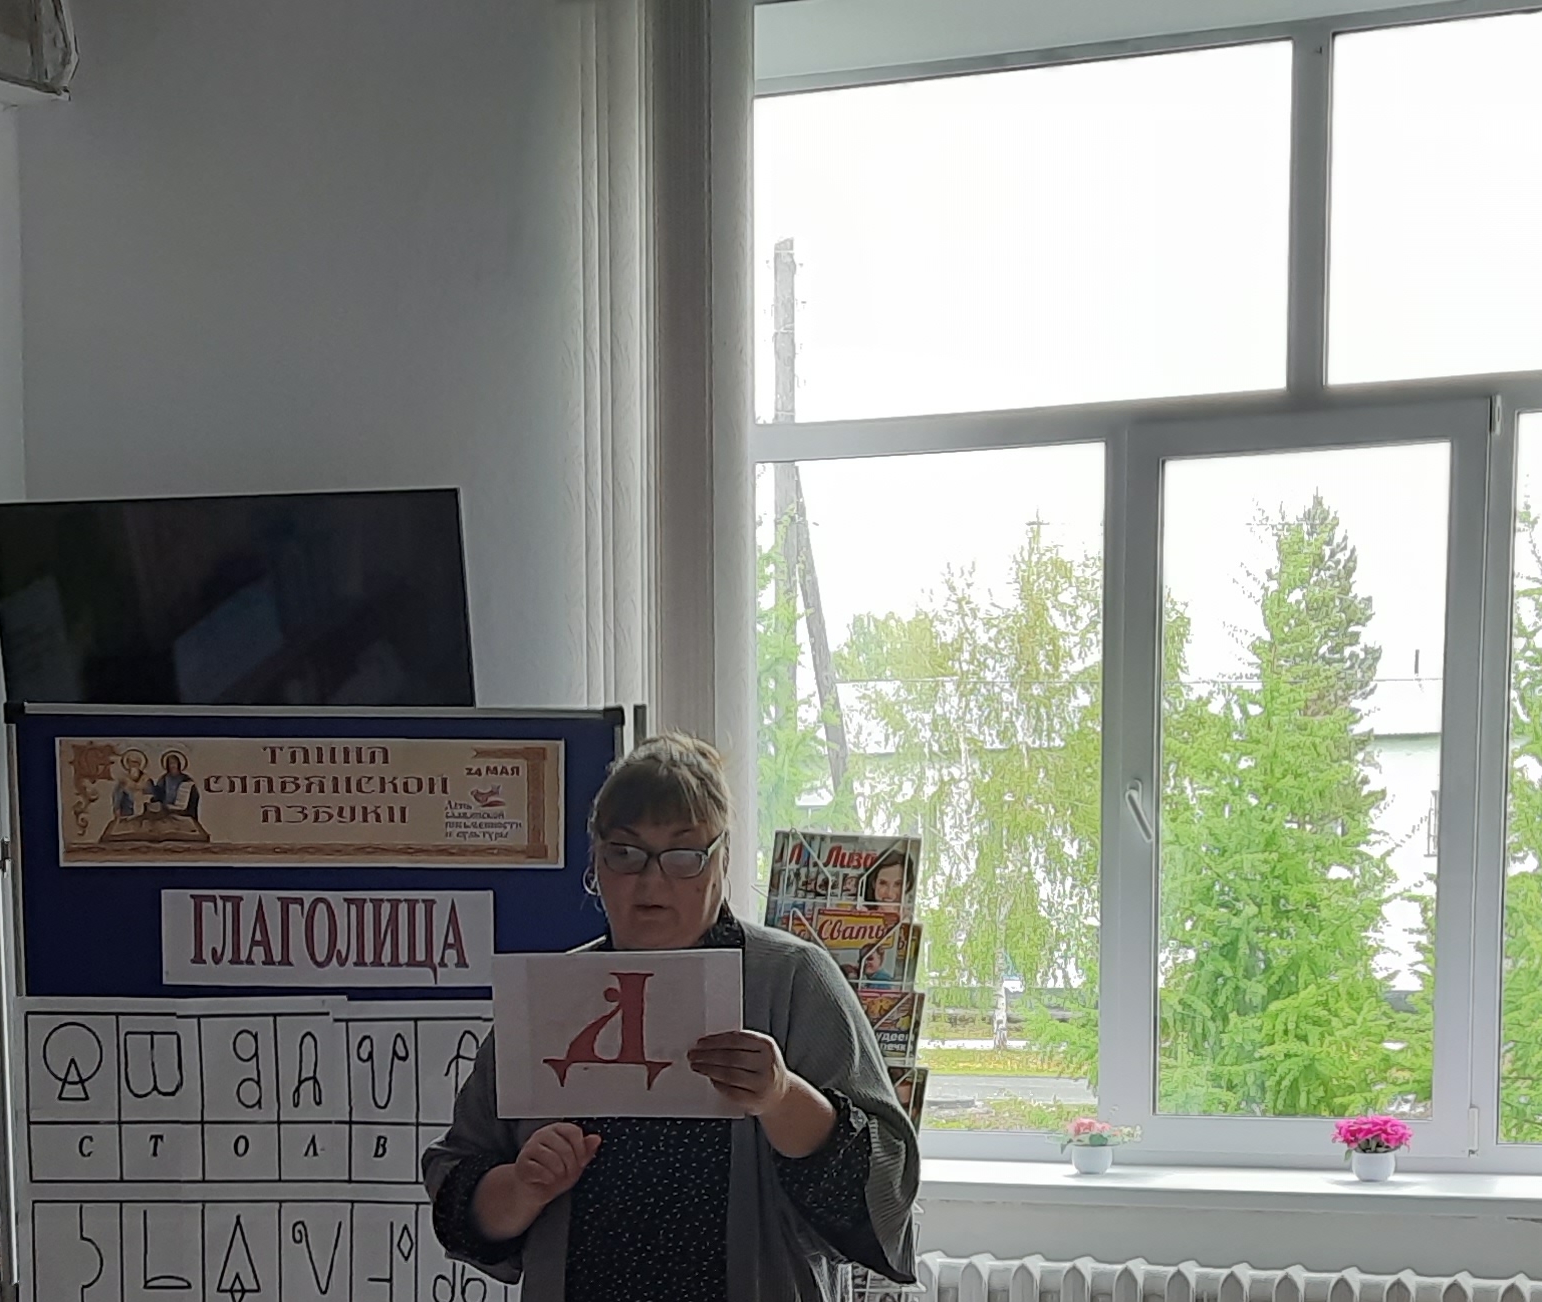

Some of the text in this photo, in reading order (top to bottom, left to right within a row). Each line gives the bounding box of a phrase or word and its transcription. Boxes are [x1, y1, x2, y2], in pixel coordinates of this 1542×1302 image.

[188, 893, 469, 984] ГЛАГОЛИЦА
[542, 972, 672, 1090] Д
[78, 1135, 94, 1159] С
[148, 1135, 165, 1159] Т
[233, 1136, 250, 1158] О
[373, 1136, 388, 1159] В
